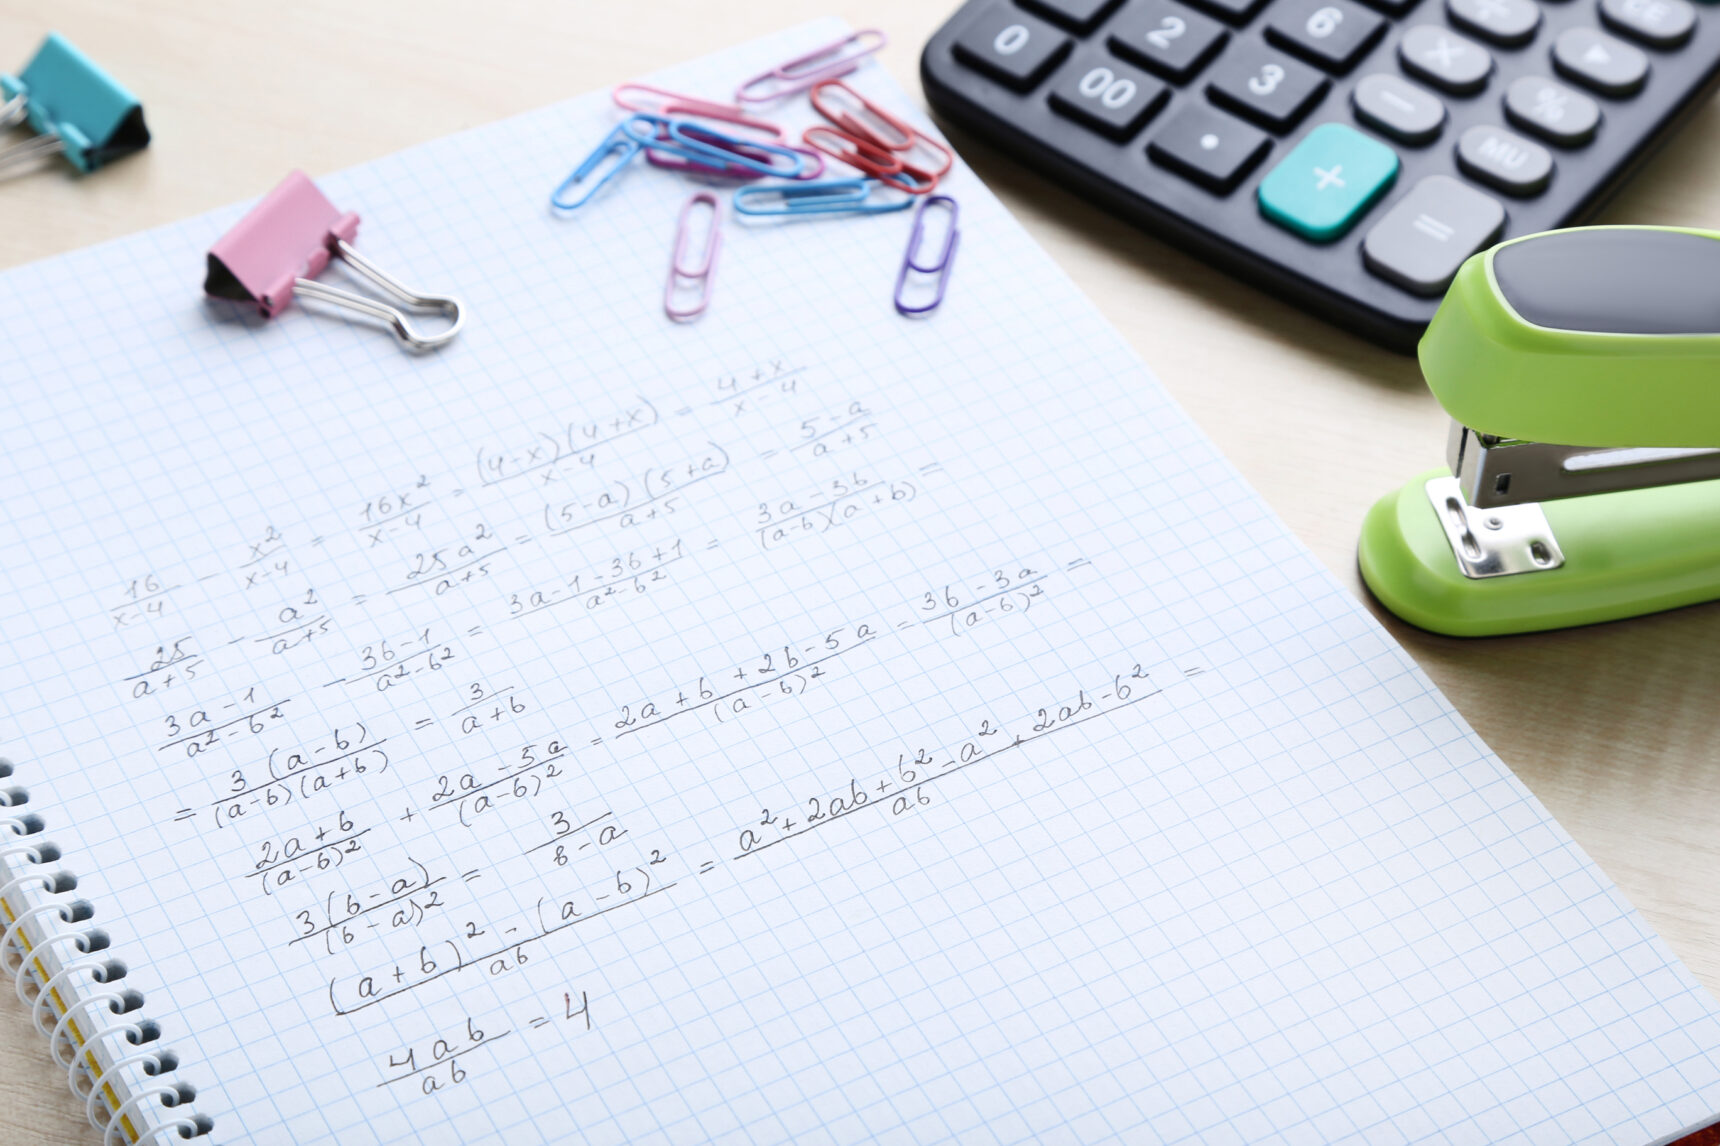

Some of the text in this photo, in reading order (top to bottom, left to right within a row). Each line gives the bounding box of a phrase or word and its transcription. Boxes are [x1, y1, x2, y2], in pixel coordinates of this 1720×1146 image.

[1146, 15, 1188, 50] 2
[1305, 6, 1345, 38] 6
[993, 24, 1030, 55] 0
[1078, 66, 1138, 109] 00
[1248, 63, 1286, 96] 3
[1478, 136, 1530, 170] MU
